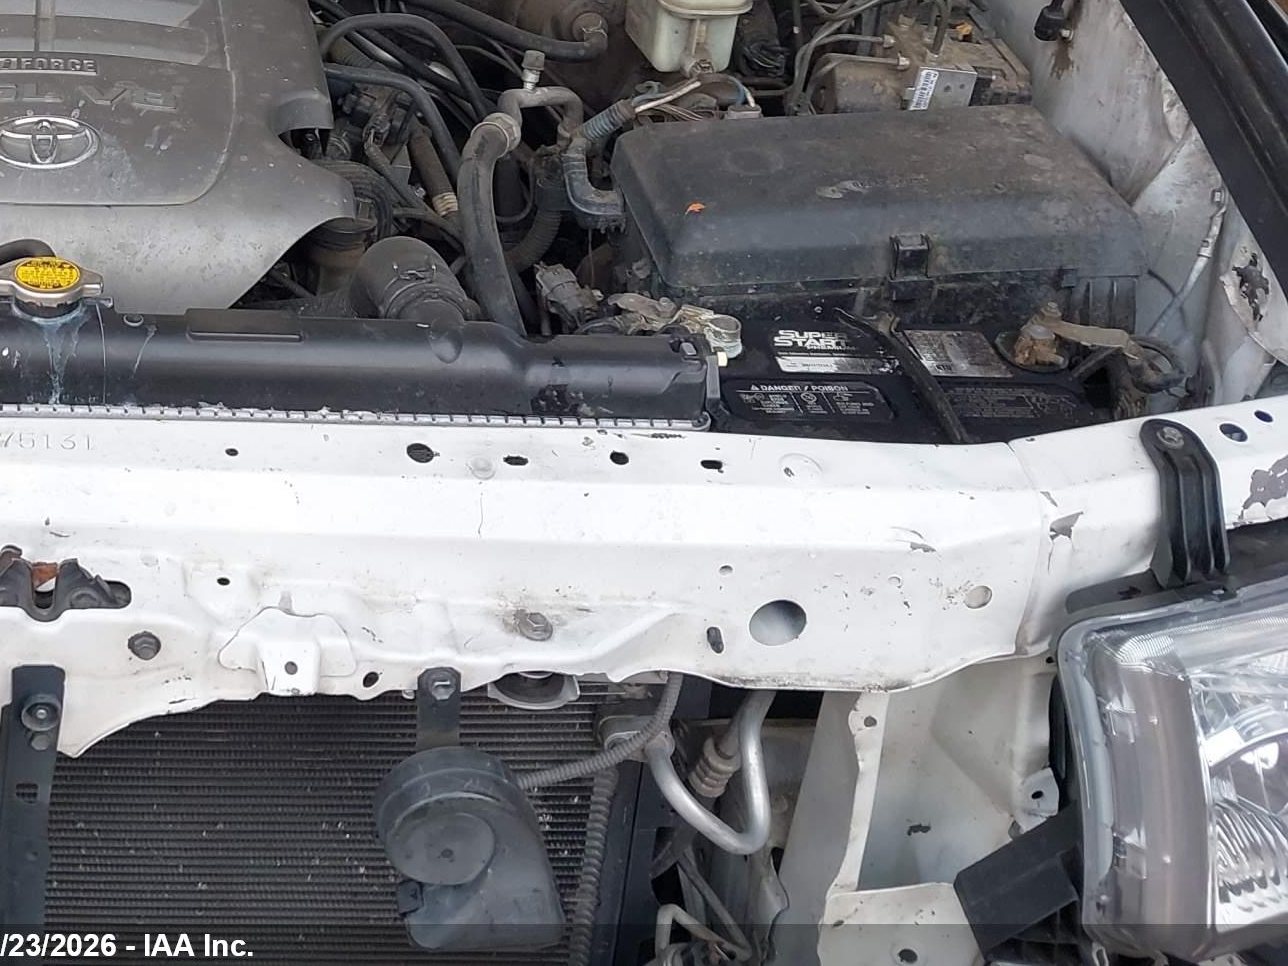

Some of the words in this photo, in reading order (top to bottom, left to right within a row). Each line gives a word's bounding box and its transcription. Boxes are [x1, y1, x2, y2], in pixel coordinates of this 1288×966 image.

[778, 329, 848, 339] SUPER
[774, 336, 849, 347] START
[760, 384, 801, 392] DANGER
[811, 384, 849, 392] POISON
